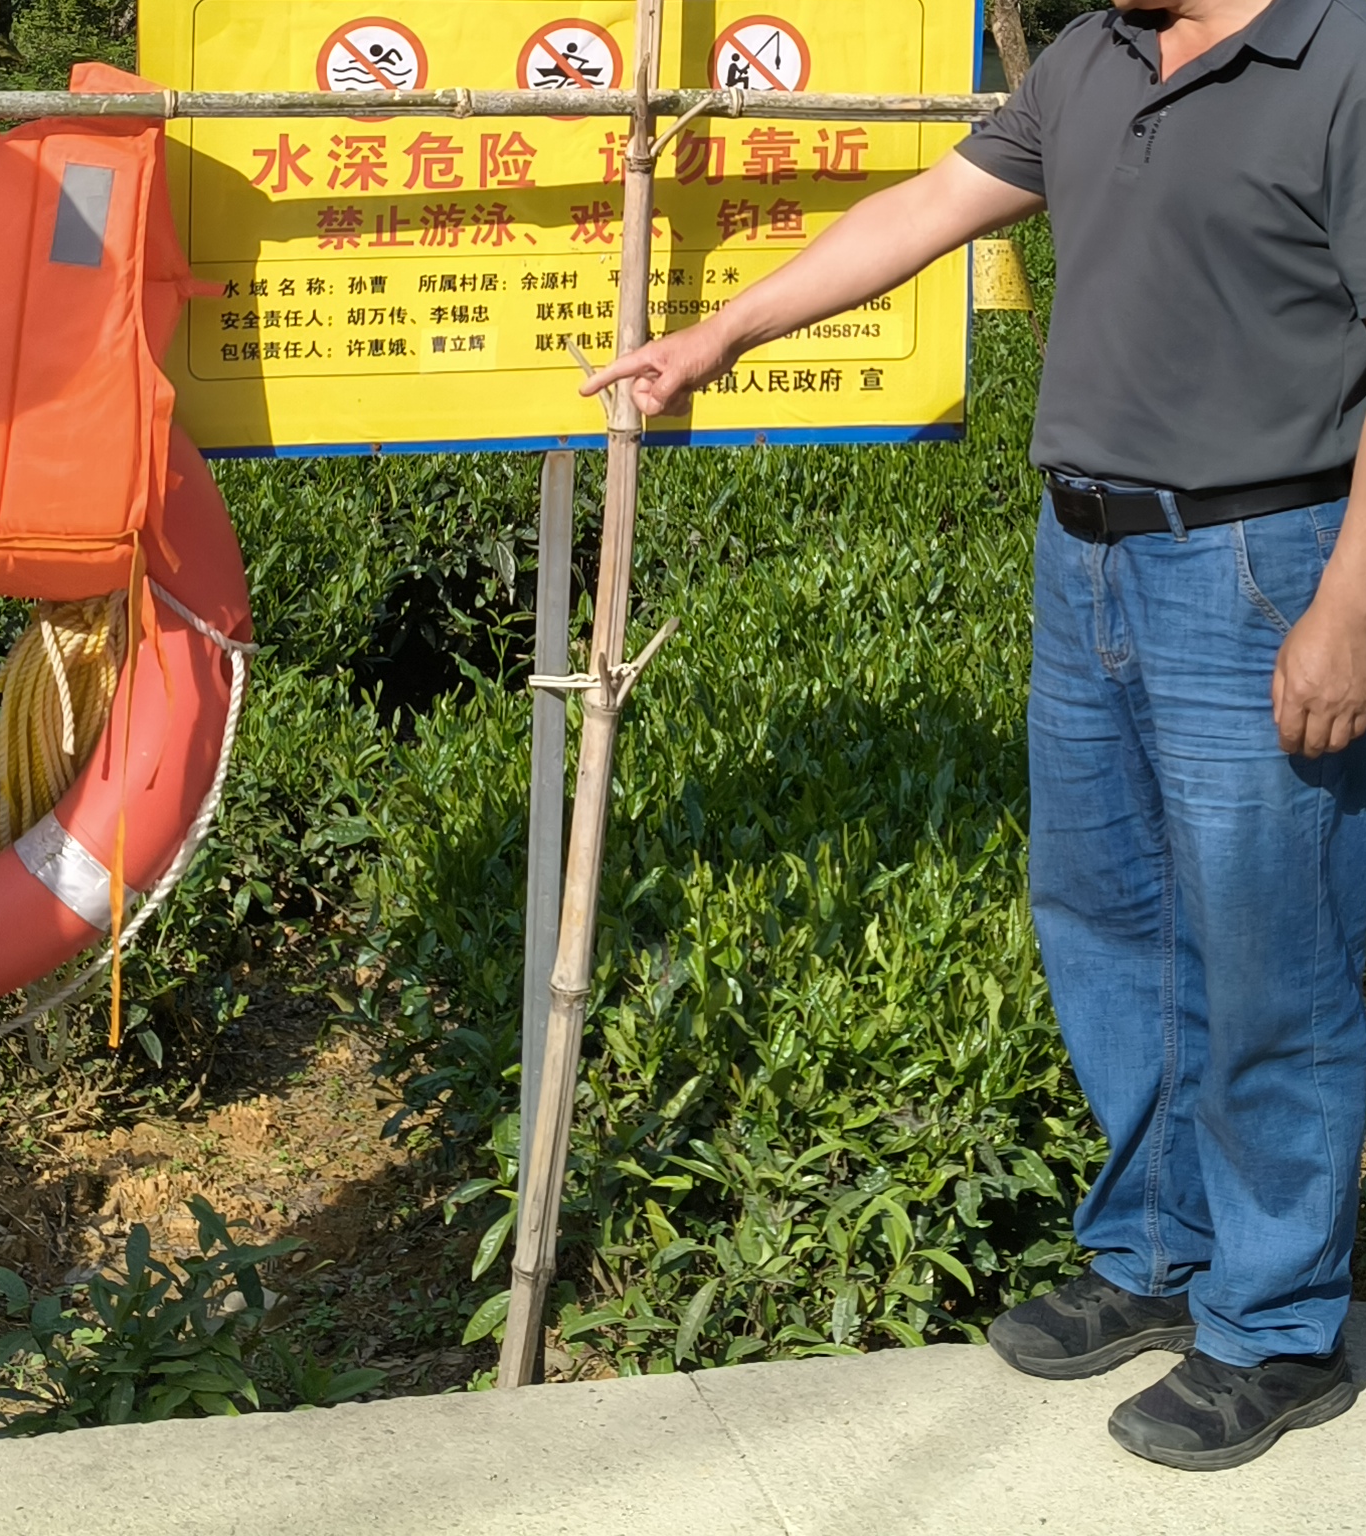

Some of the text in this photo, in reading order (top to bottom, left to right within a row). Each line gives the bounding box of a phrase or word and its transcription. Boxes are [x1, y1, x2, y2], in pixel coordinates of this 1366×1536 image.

[251, 131, 537, 193] 水深危险
[694, 367, 884, 395] 镇人民政府 宣
